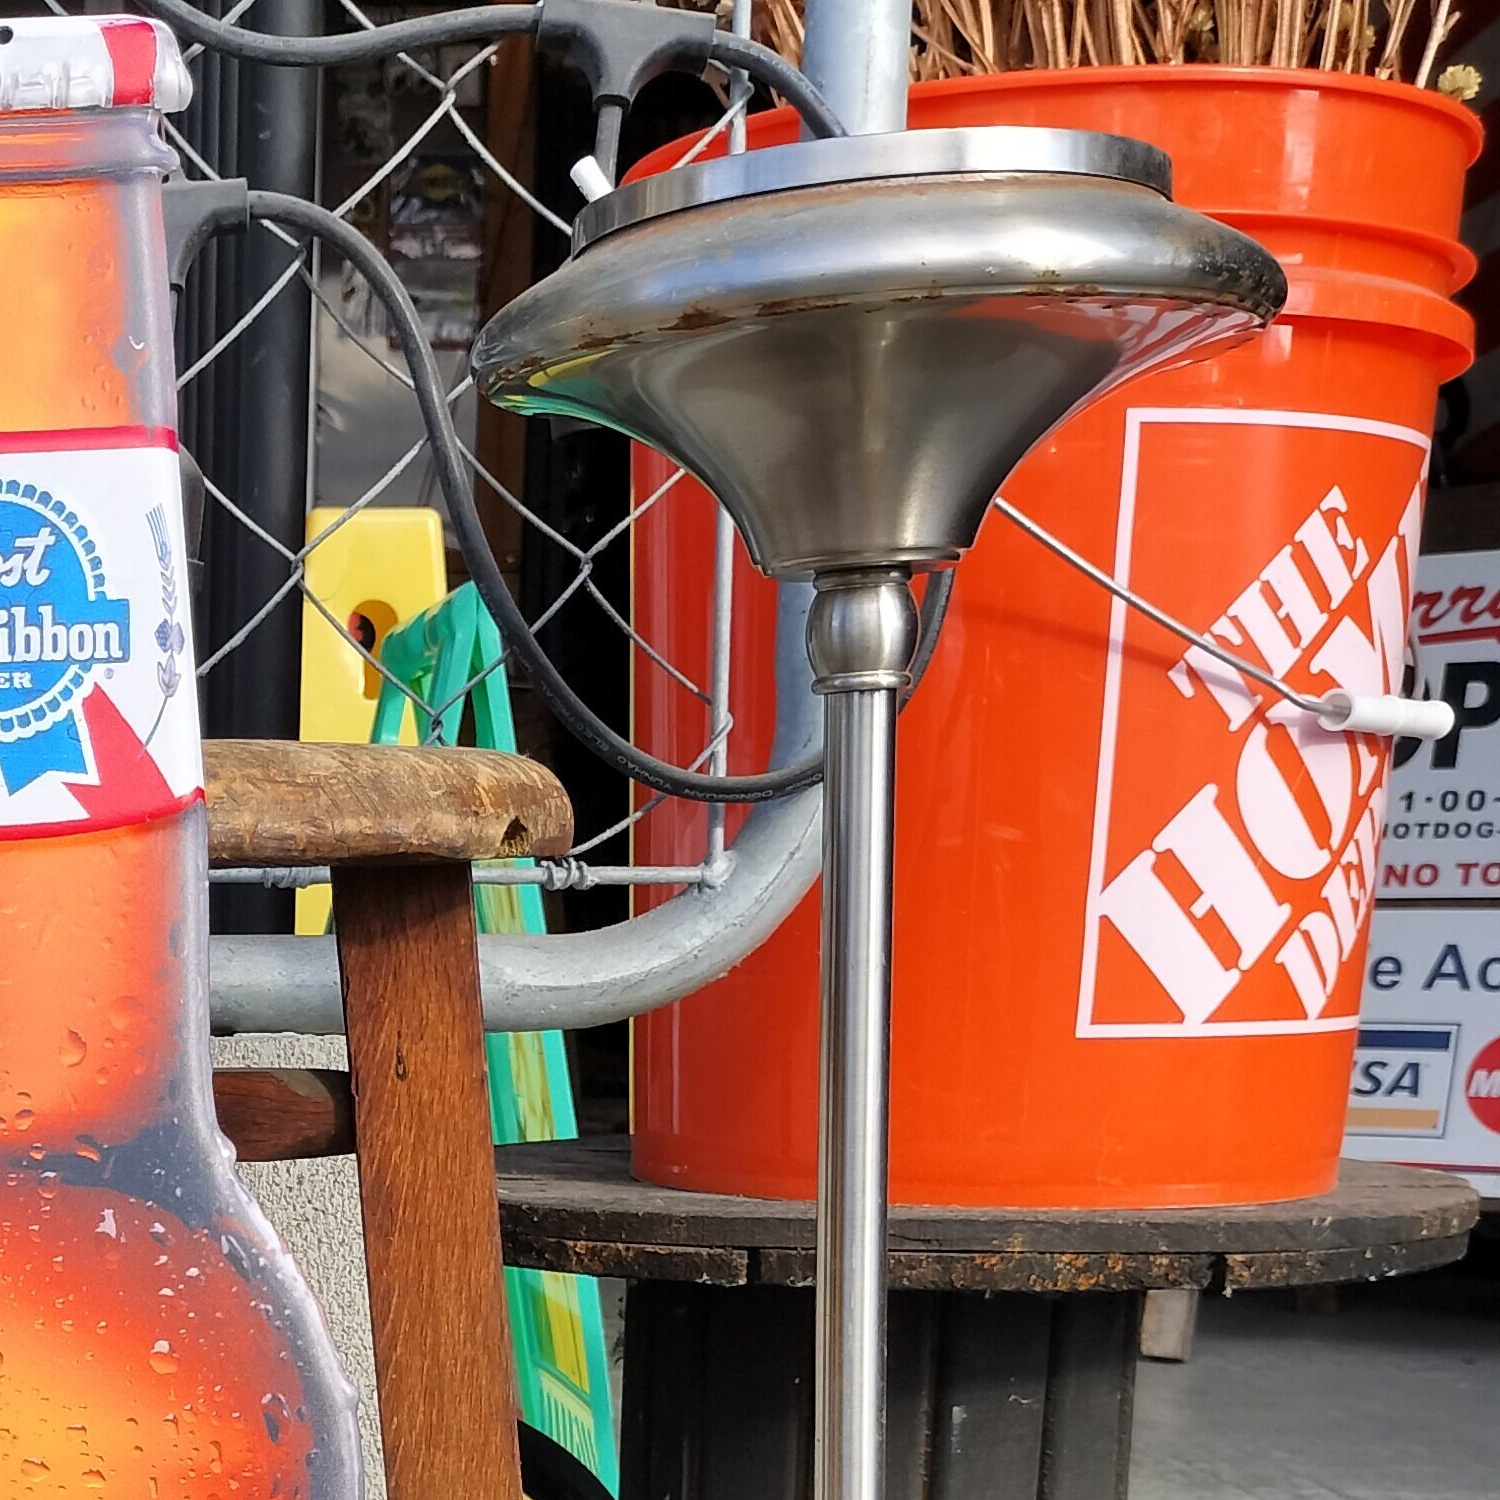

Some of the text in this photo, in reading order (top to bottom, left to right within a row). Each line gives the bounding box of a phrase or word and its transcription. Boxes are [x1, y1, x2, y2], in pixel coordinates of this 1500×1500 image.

[1167, 484, 1369, 733] THE
[616, 755, 672, 791] YUNHAO
[1383, 863, 1439, 888] NO
[1352, 1059, 1421, 1098] SA
